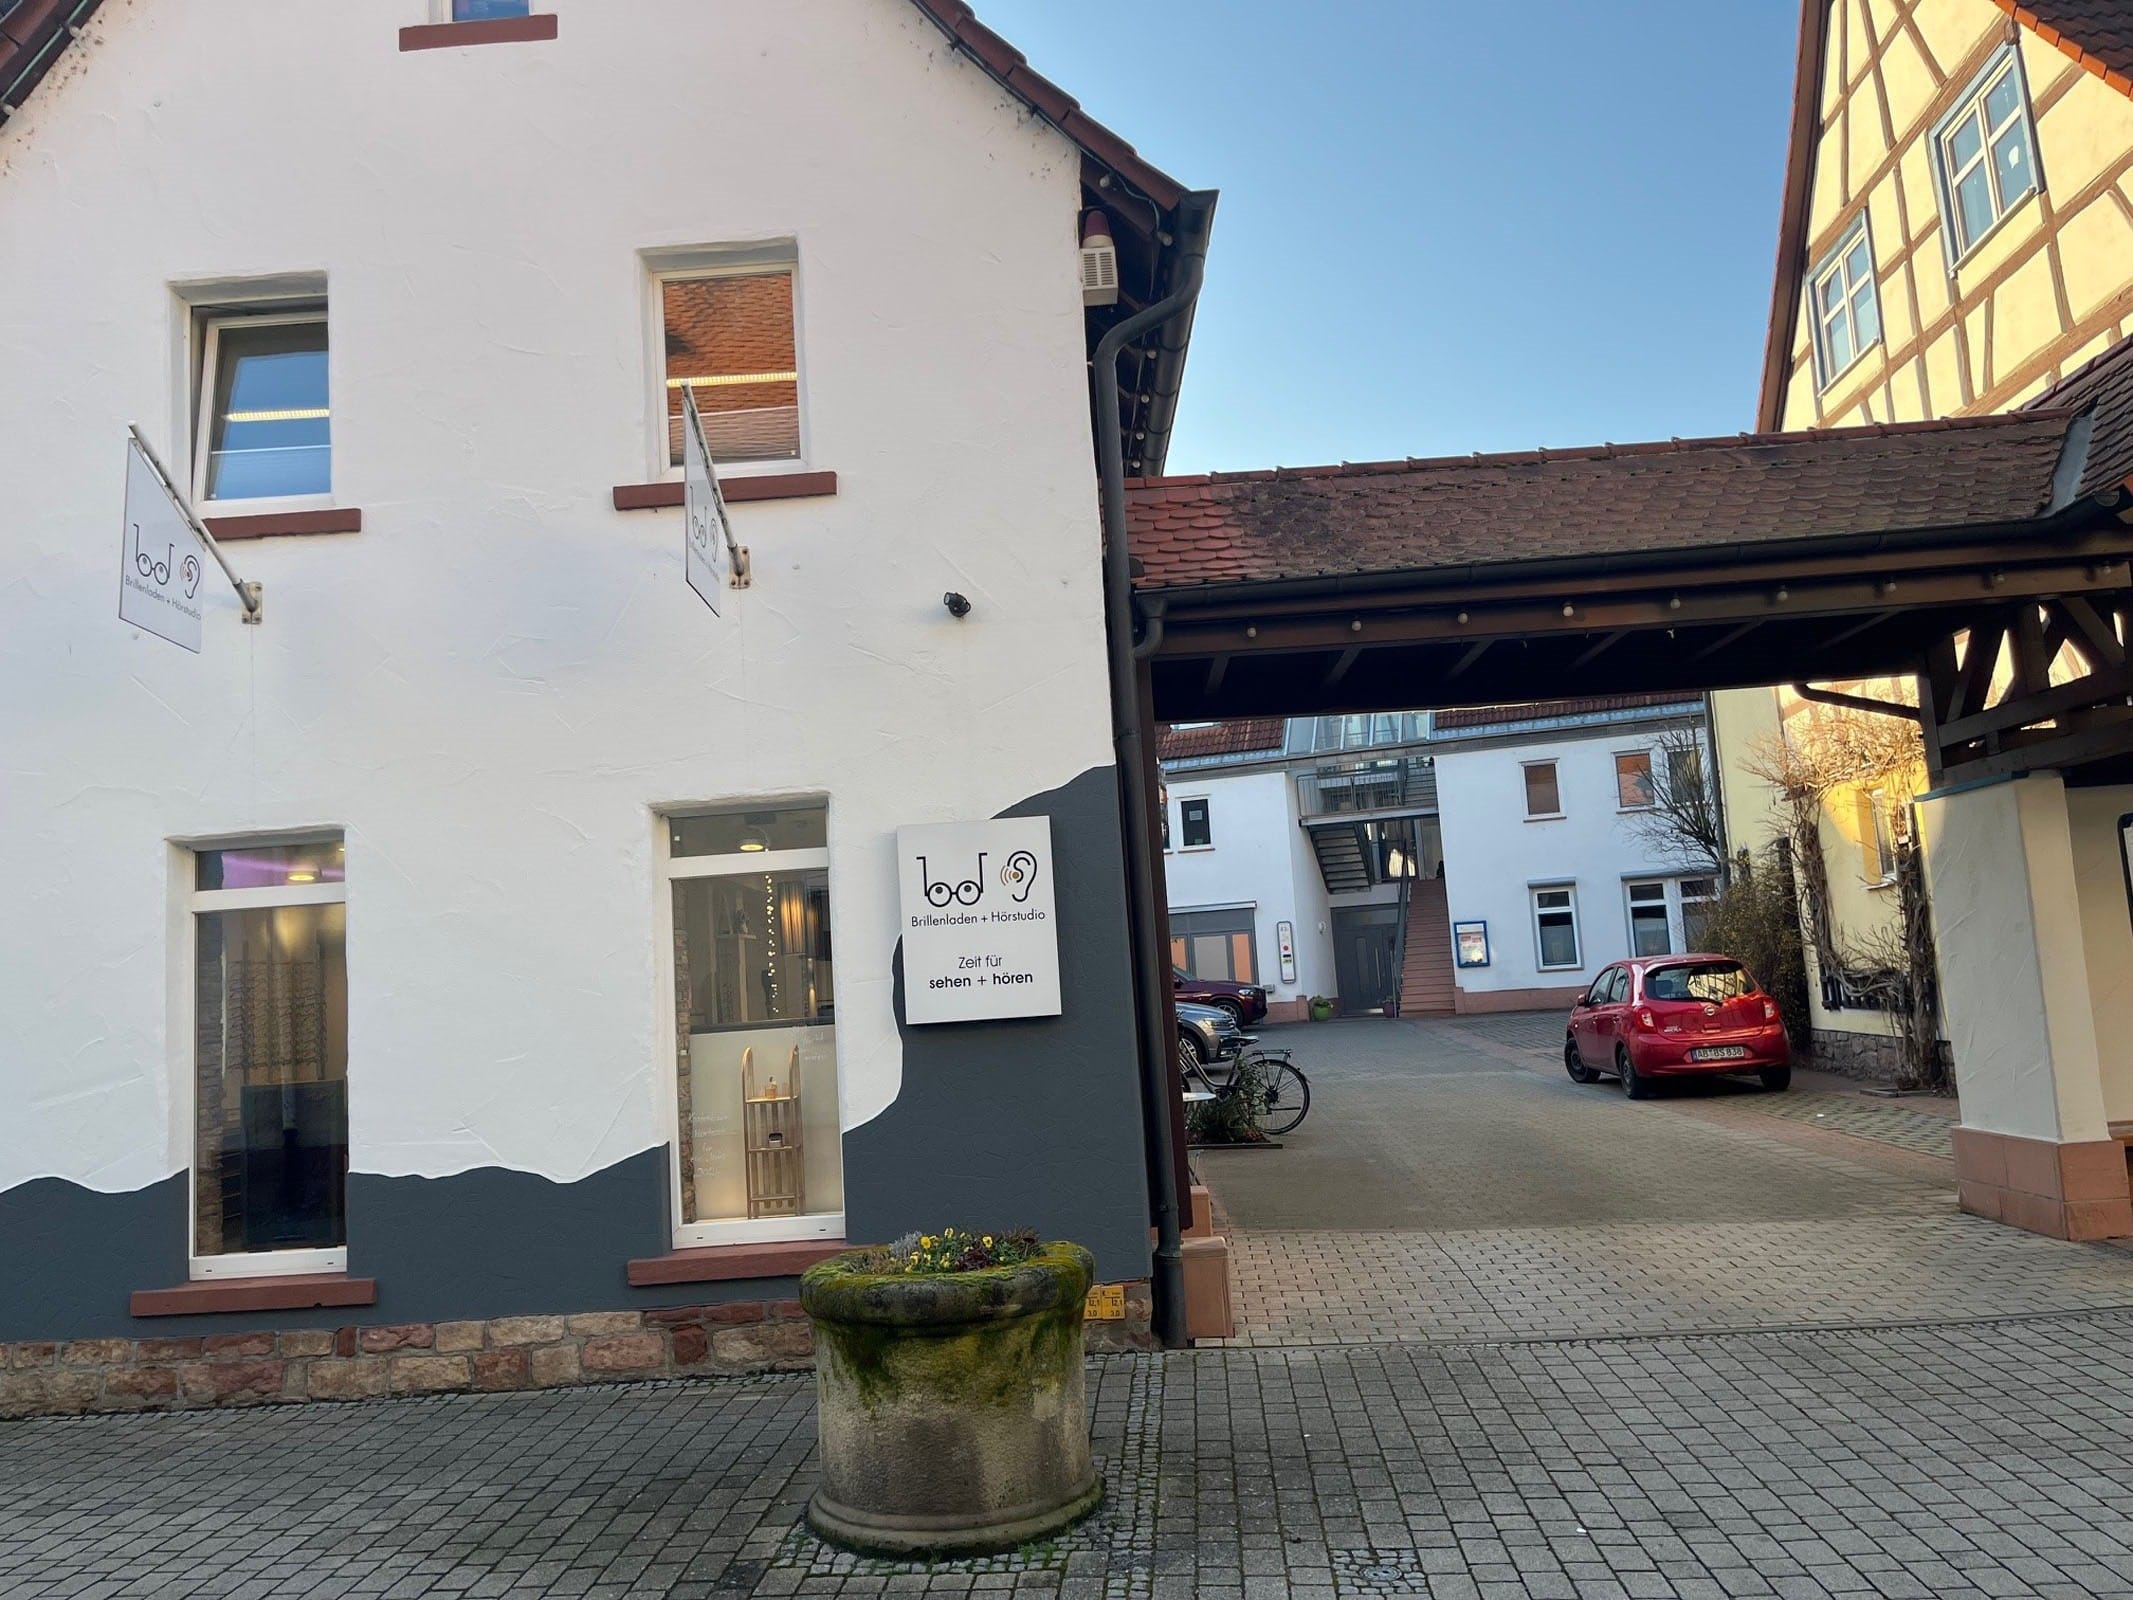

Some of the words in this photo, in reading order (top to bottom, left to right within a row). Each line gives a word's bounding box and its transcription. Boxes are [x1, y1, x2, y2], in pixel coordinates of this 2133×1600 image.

[911, 913, 978, 927] Brillenladen
[981, 915, 989, 923] +
[991, 908, 1046, 922] Hörstudio
[958, 956, 981, 969] Zeit
[986, 955, 1003, 967] für
[929, 976, 971, 989] sehen
[977, 976, 987, 986] +
[992, 972, 1033, 985] hören
